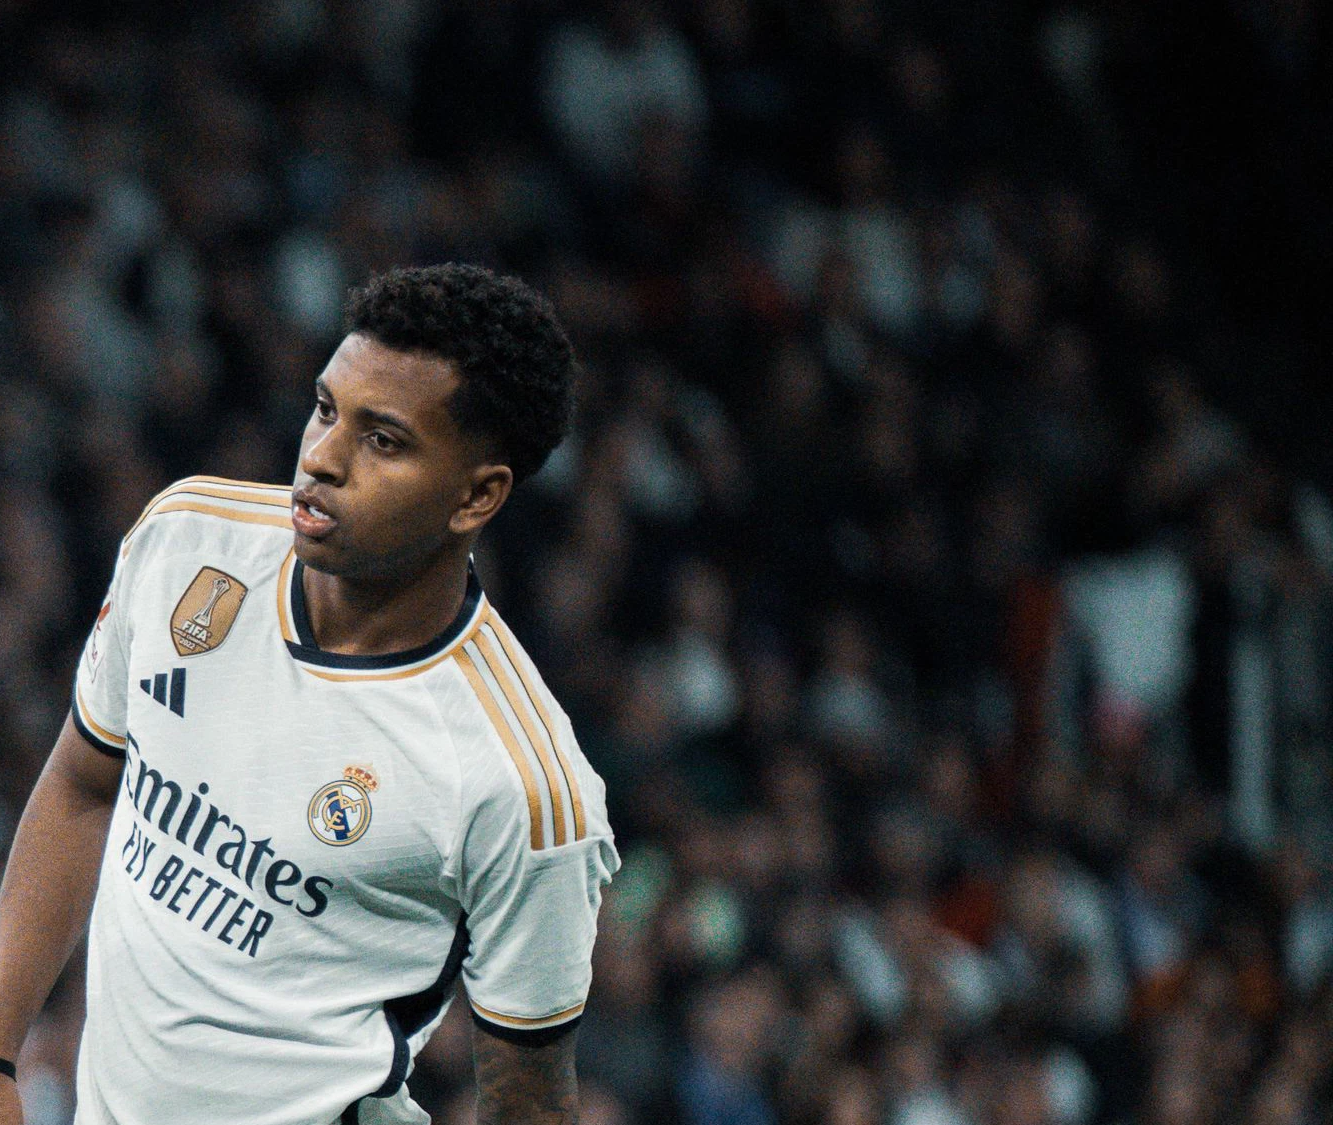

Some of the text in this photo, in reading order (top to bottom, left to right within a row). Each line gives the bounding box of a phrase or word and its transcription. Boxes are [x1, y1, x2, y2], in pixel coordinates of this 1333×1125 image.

[181, 619, 208, 642] FIFA
[122, 821, 275, 958] FLY BETTER
